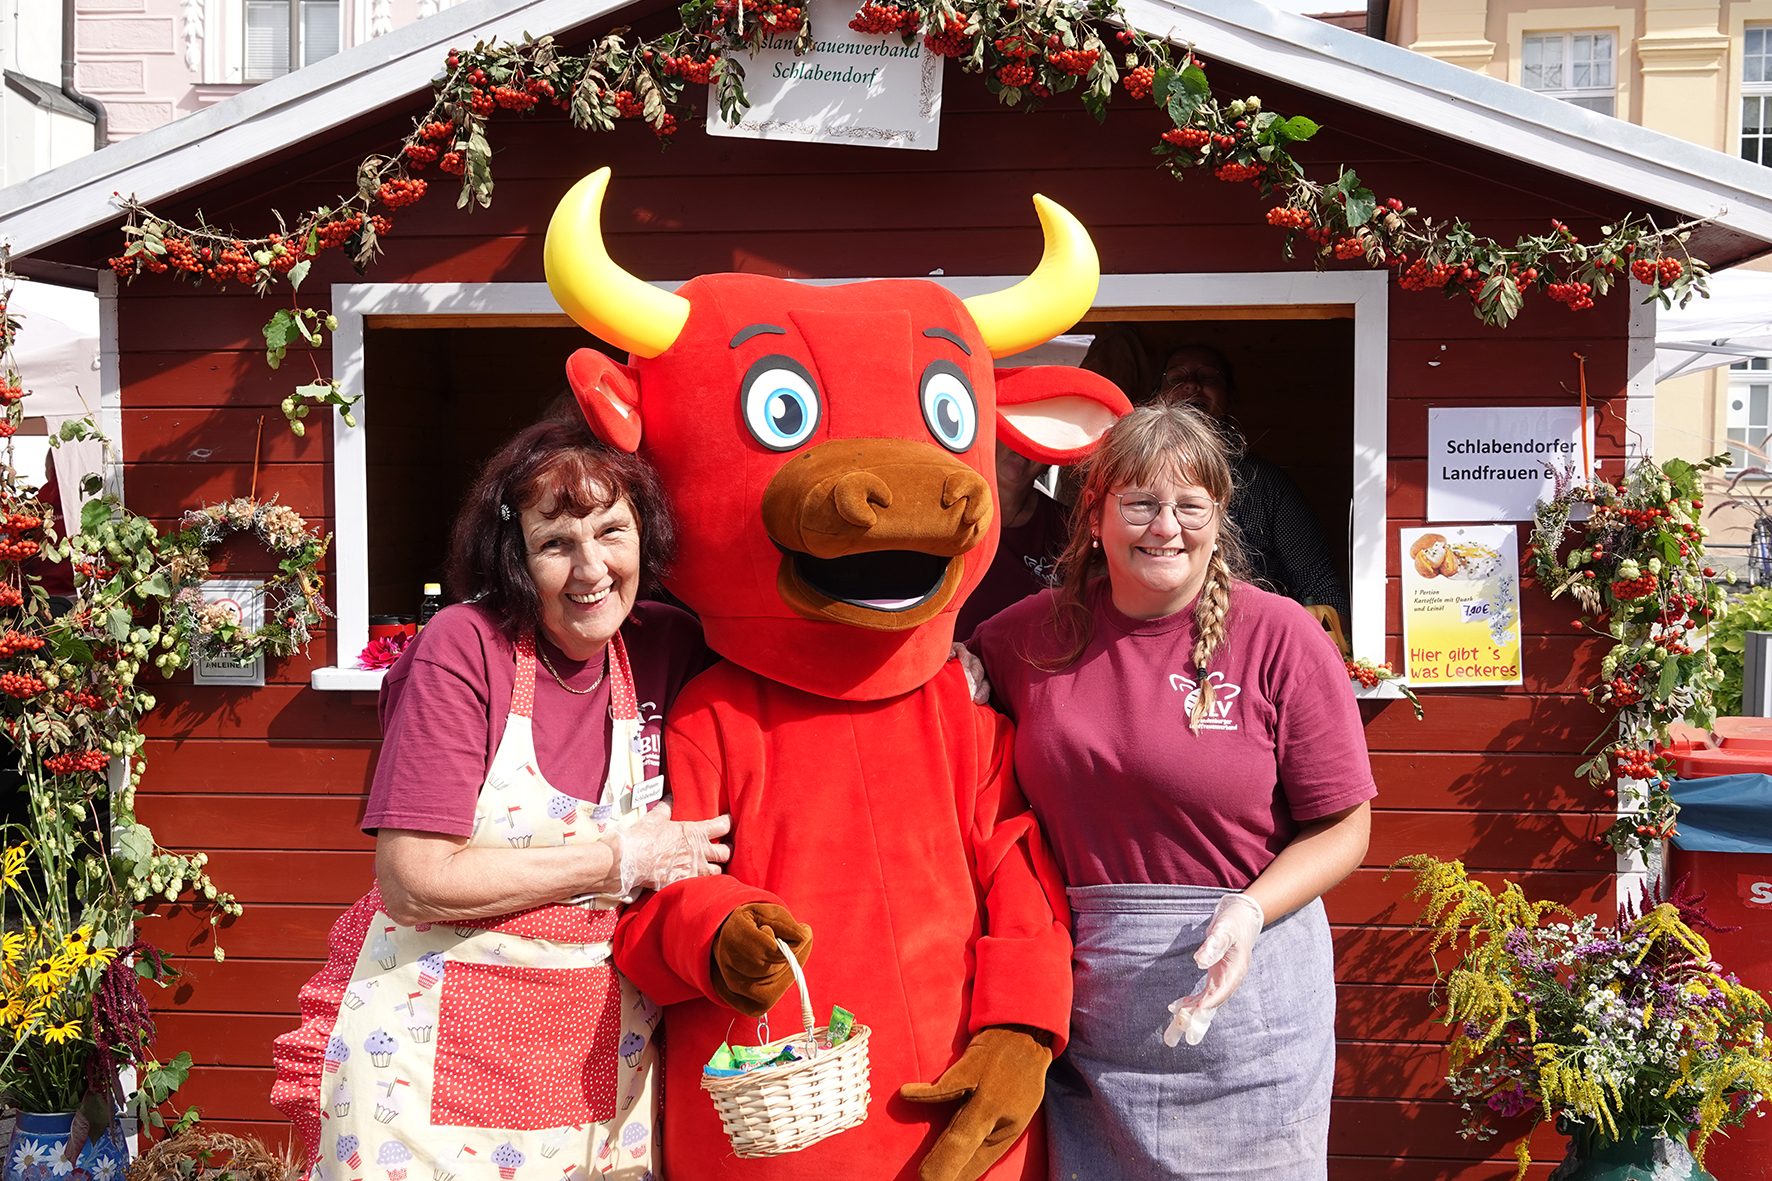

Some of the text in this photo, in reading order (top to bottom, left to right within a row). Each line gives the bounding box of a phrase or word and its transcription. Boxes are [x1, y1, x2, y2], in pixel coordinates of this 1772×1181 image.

[773, 62, 878, 88] Schlabendorf
[1446, 438, 1577, 454] Schlabendorfer
[1442, 465, 1538, 480] Landfrauen
[1410, 648, 1442, 662] Hier
[1448, 647, 1479, 662] gibt
[1410, 663, 1518, 679] was Leckeres
